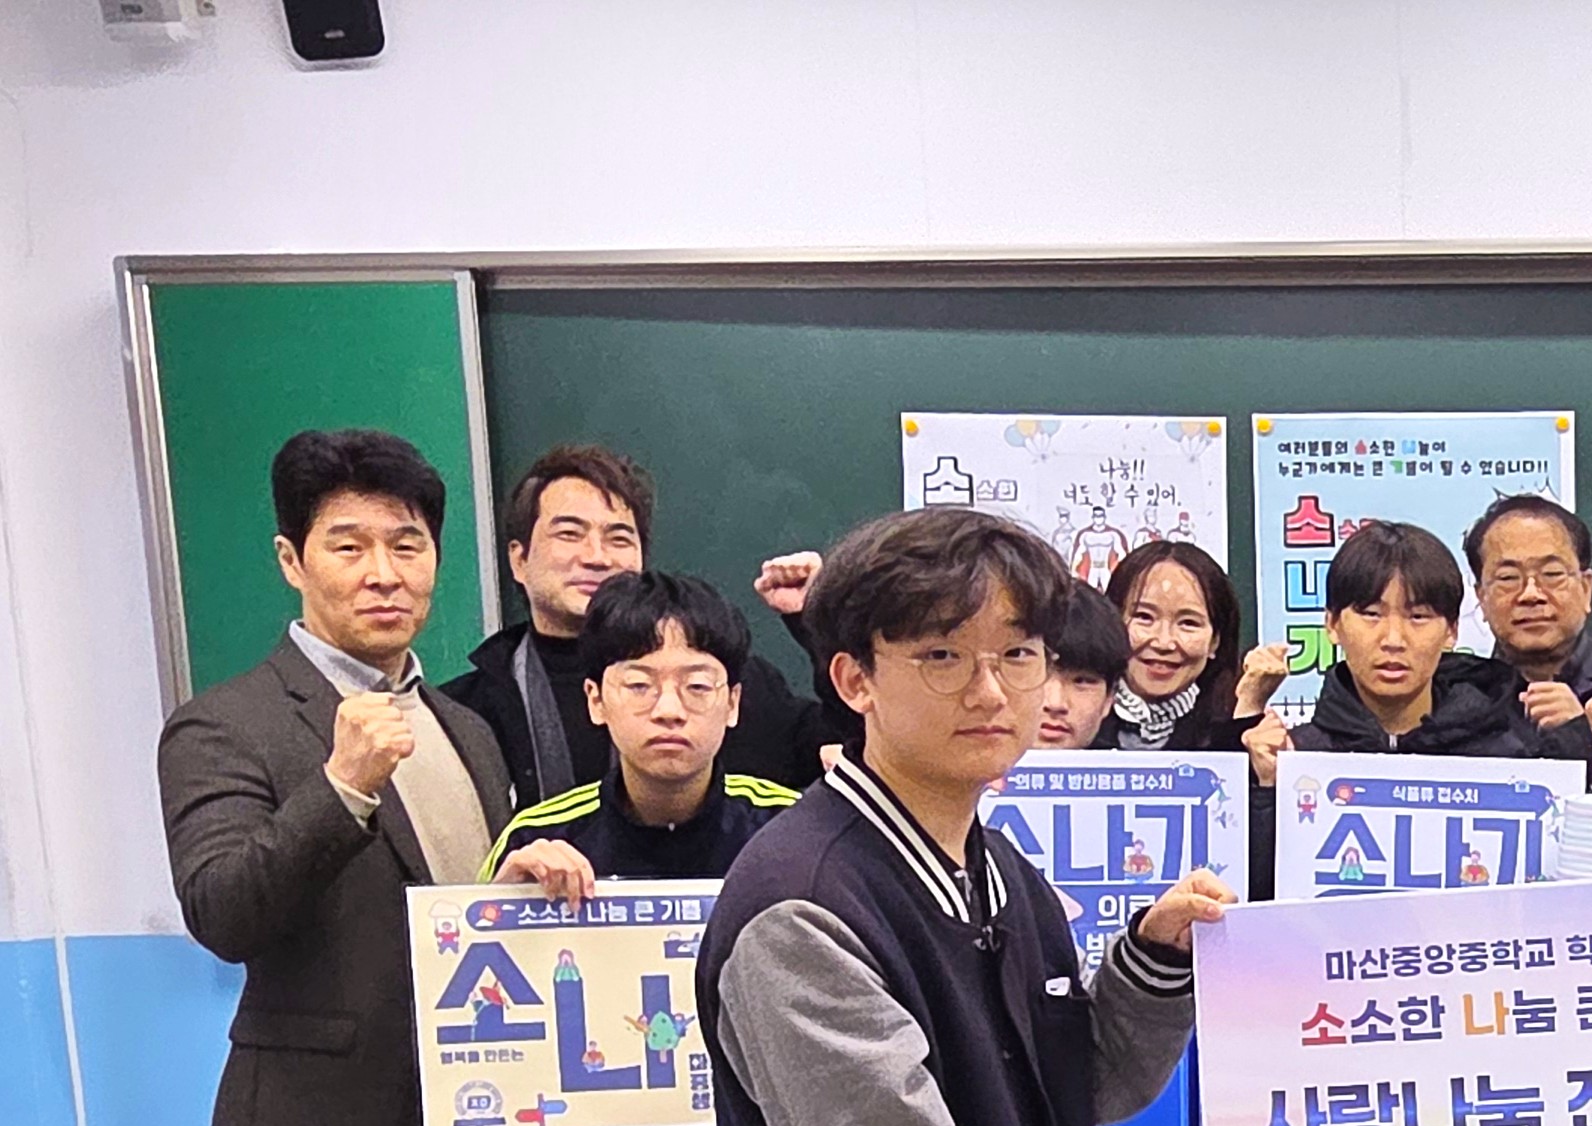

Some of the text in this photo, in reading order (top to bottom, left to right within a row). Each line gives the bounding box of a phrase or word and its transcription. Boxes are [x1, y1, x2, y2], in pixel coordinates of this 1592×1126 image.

[1278, 440, 1348, 455] 여러분들의
[1124, 484, 1139, 508] 수
[1147, 483, 1181, 506] 있어.
[1315, 813, 1543, 888] 소나기
[586, 902, 627, 923] 나눔
[1325, 937, 1556, 981] 마산중앙중학교
[1300, 994, 1445, 1046] 소소한
[1462, 989, 1557, 1035] 나눔
